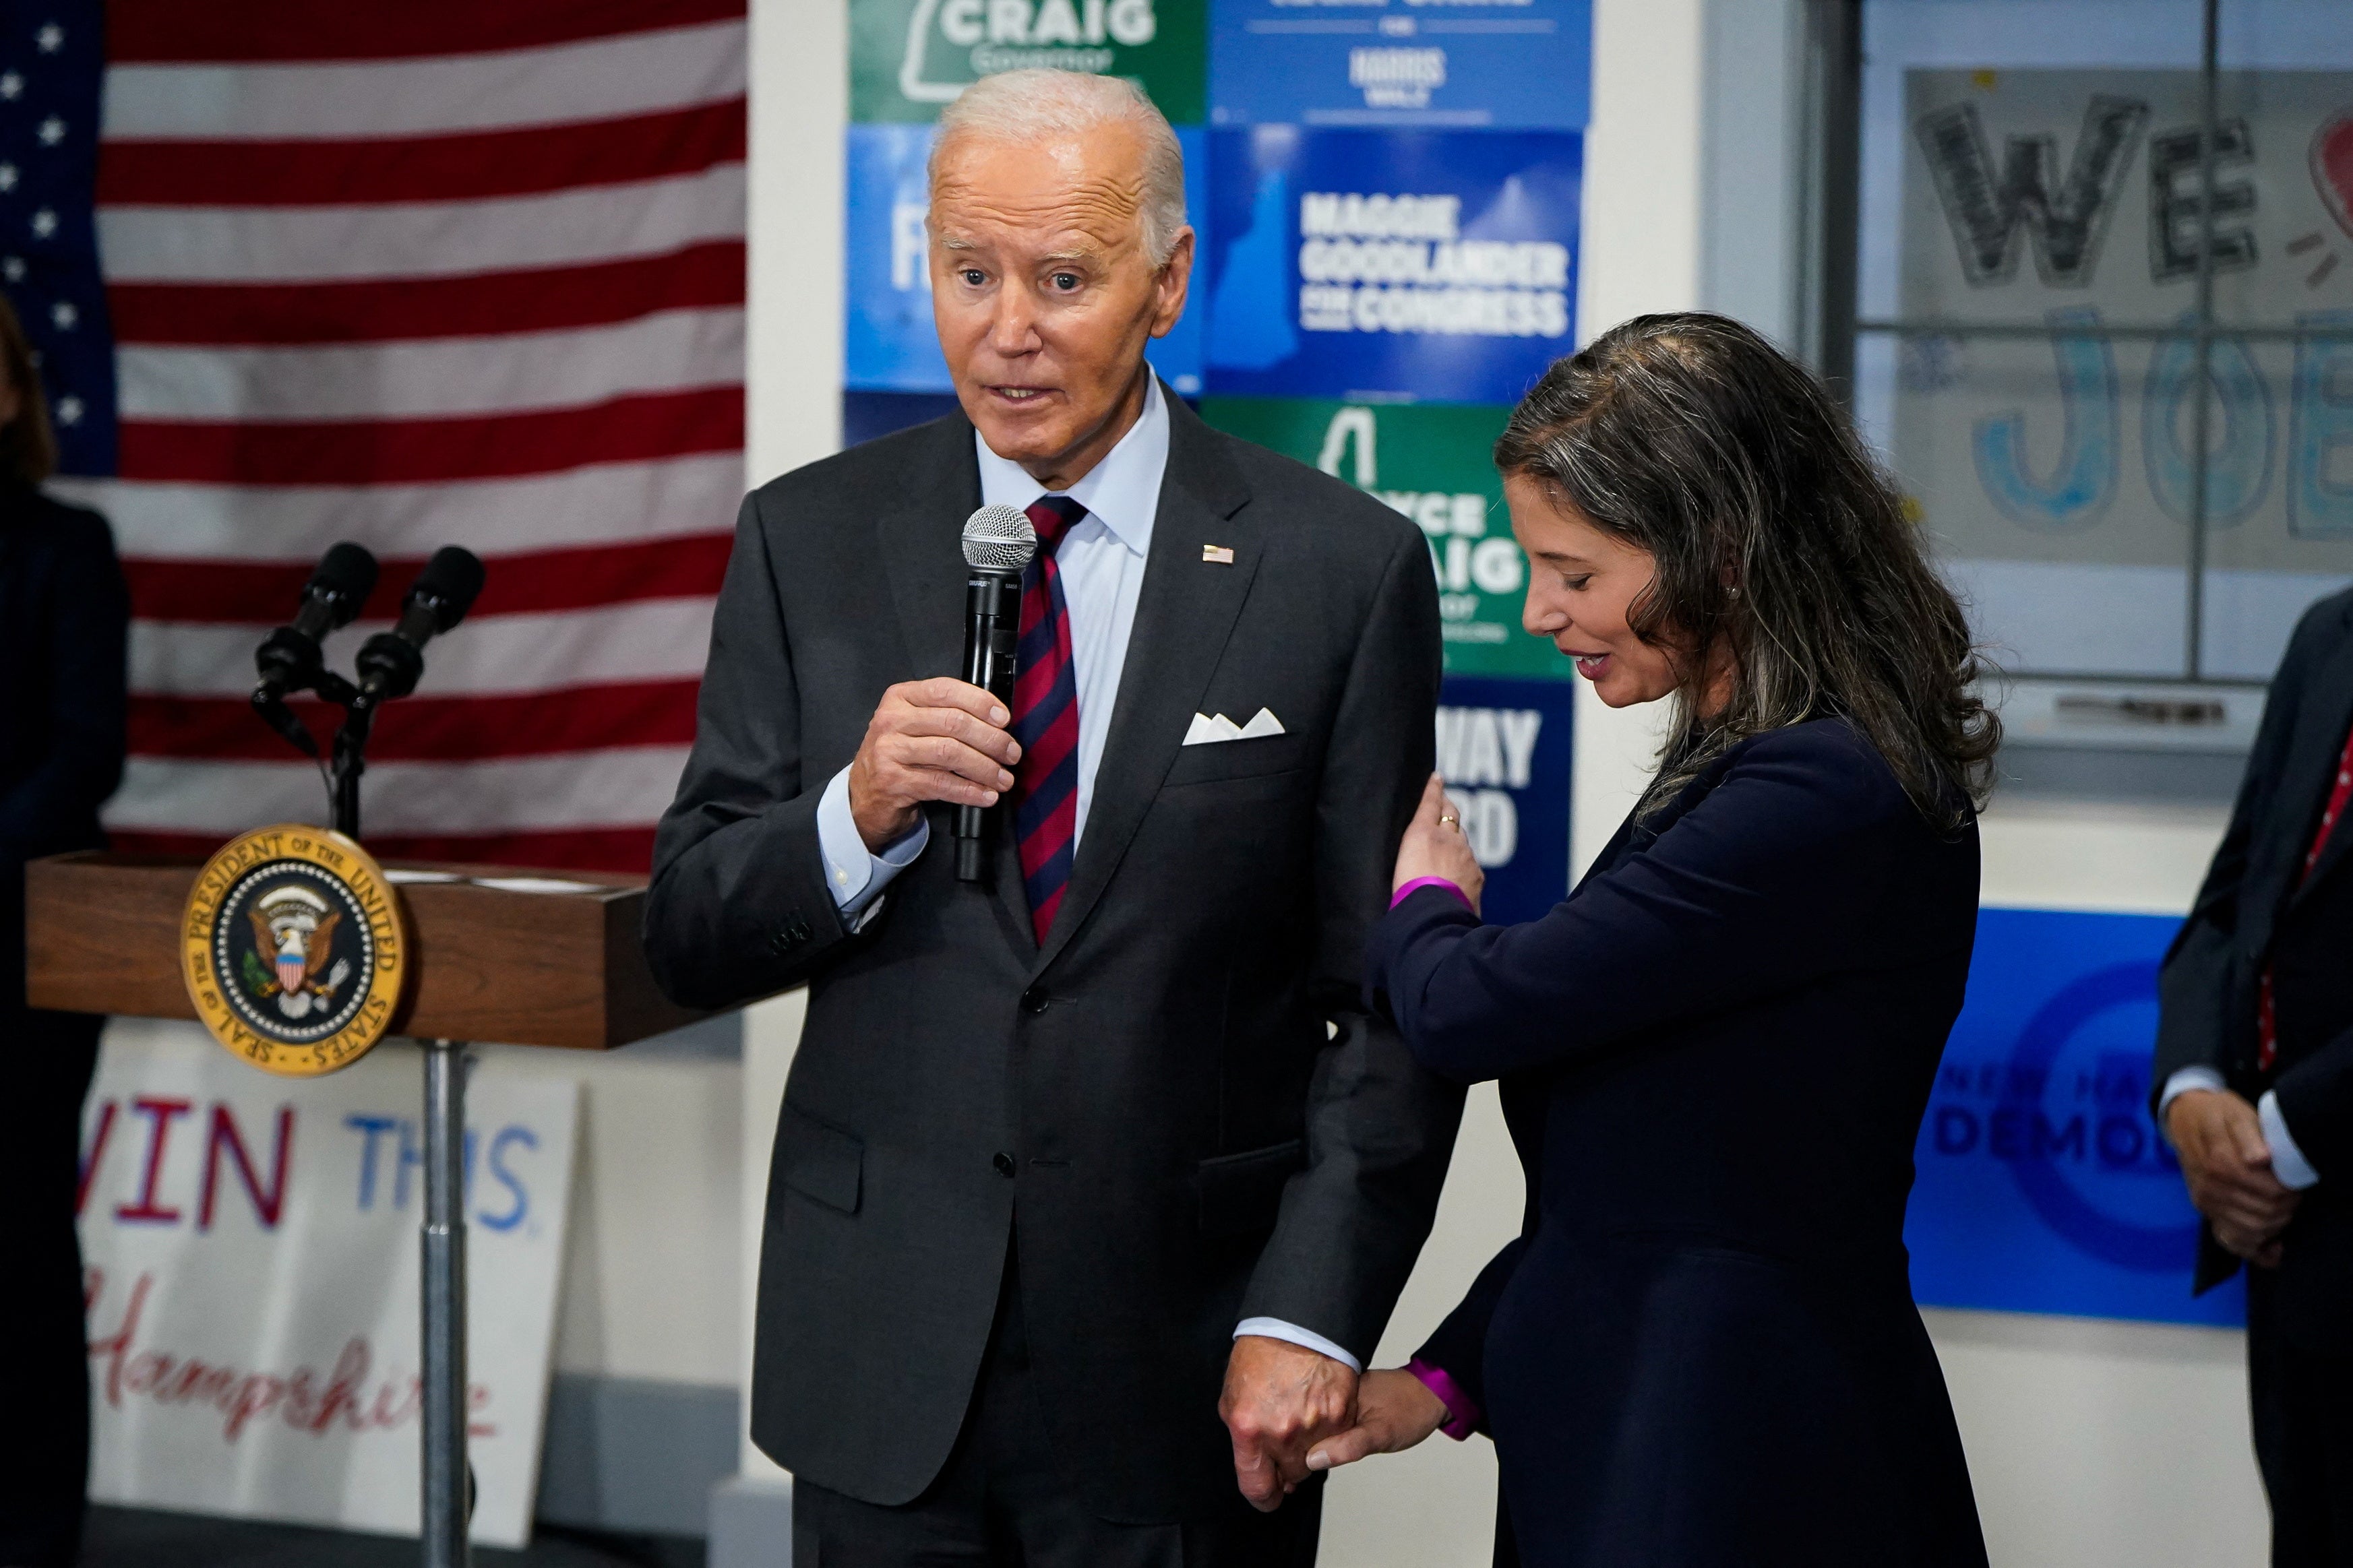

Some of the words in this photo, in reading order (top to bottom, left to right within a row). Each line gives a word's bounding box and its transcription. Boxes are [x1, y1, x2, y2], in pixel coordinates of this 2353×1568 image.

[941, 0, 1156, 46] CRAIG
[1300, 192, 1460, 238] MAGGIE
[1914, 93, 2259, 290] WE
[1299, 236, 1570, 288] GOODLANDER
[1352, 288, 1569, 338] CONGRESS
[291, 838, 311, 852] OF
[316, 844, 344, 868] THE
[187, 833, 284, 940] PRESIDENT
[348, 867, 397, 972] UNITED
[218, 1009, 273, 1063] SEAL
[313, 994, 388, 1066] STATES
